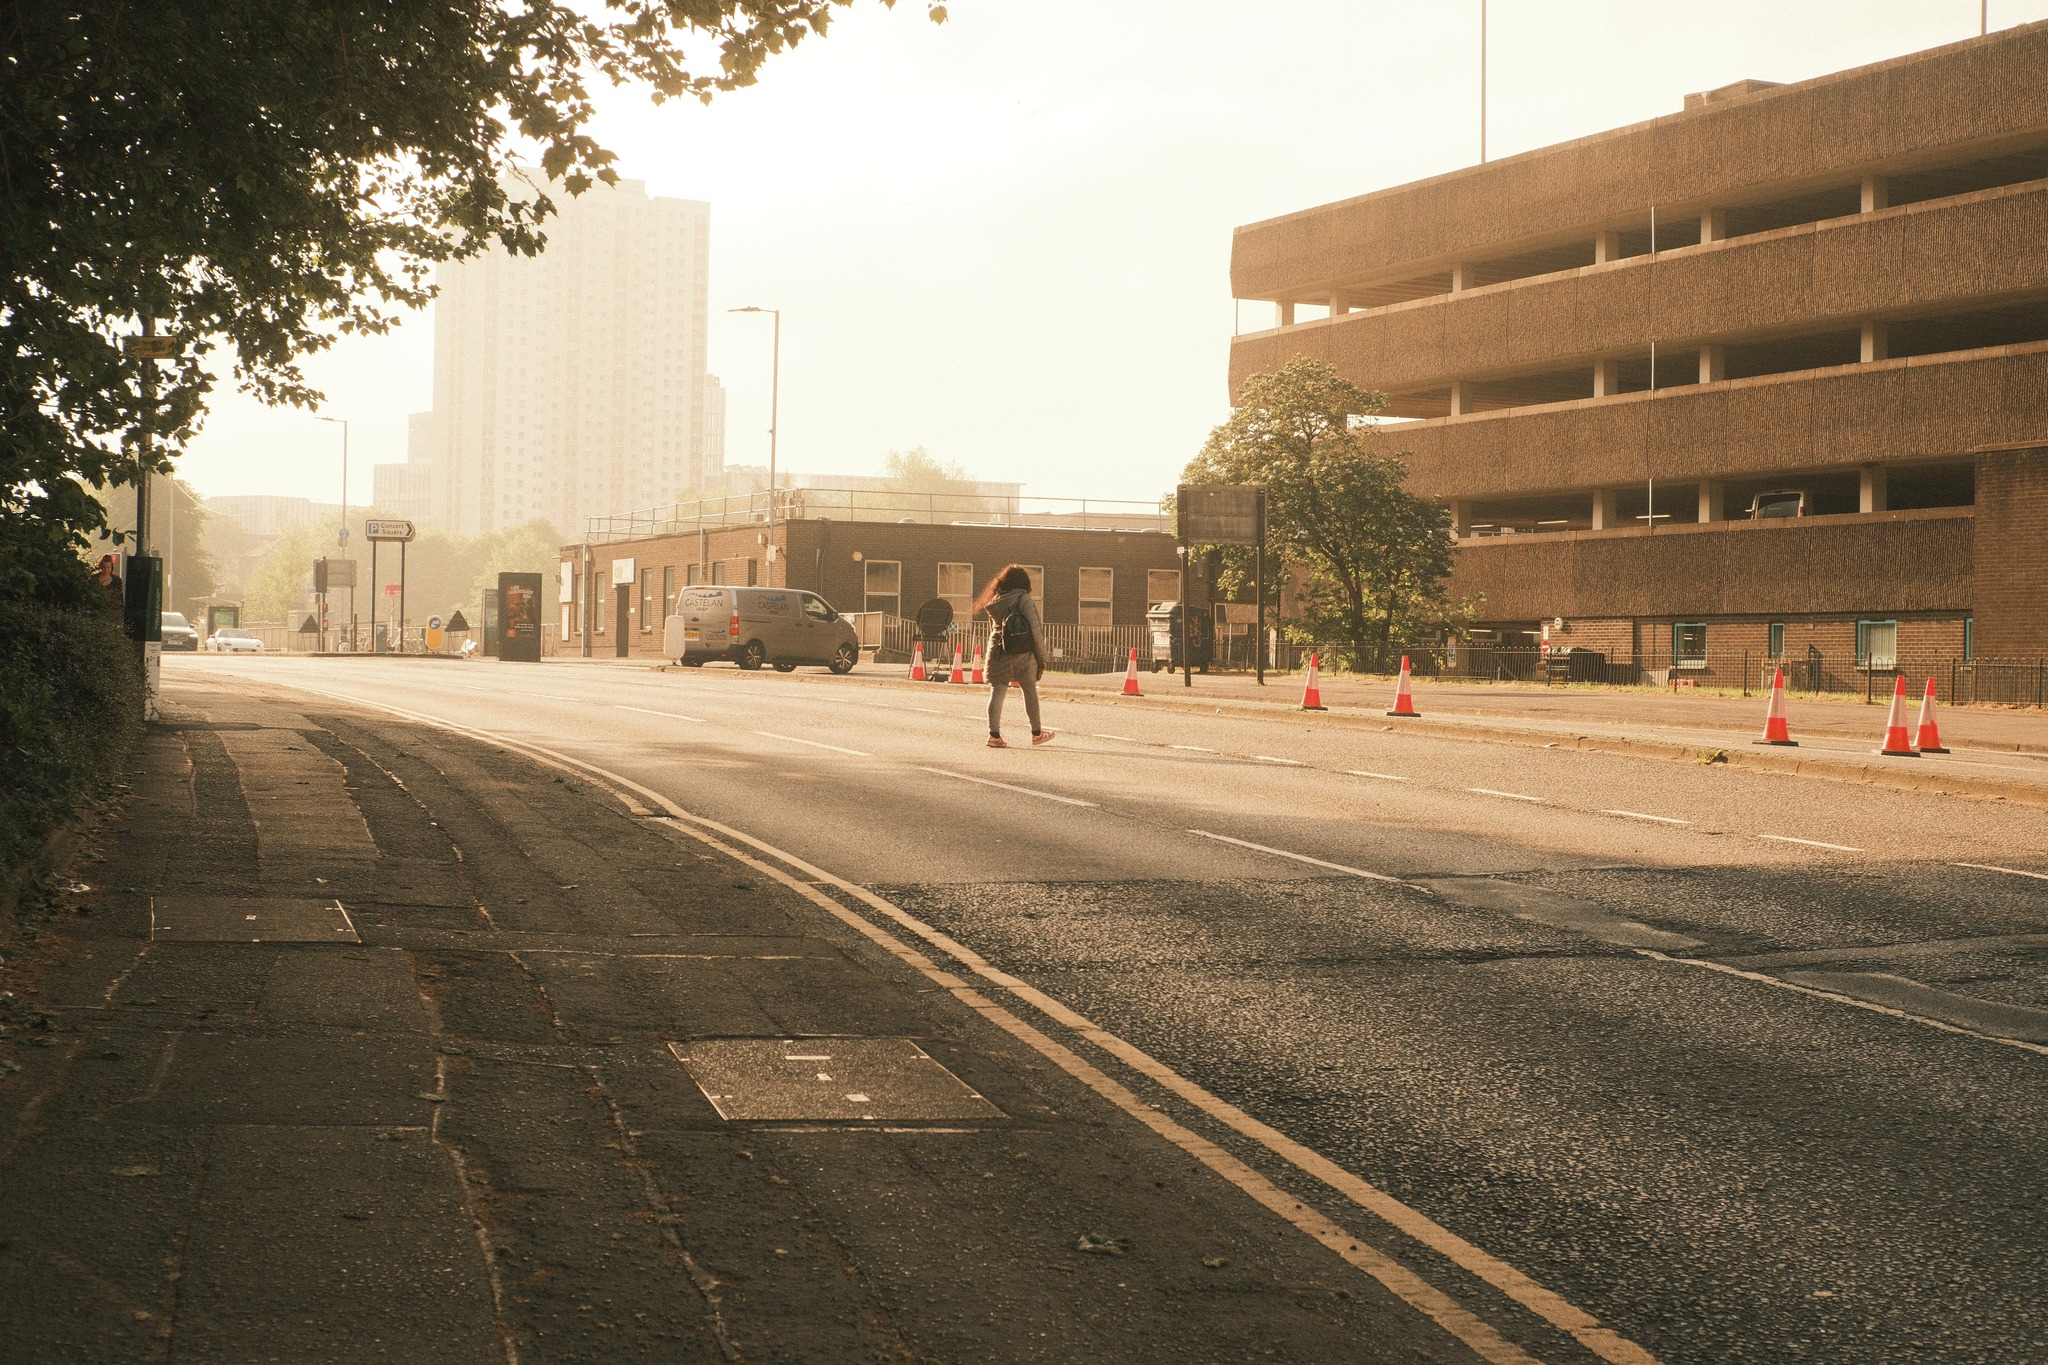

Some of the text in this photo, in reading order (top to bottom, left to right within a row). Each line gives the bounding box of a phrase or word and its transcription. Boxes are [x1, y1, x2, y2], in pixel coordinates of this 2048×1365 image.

[370, 524, 378, 534] P
[685, 599, 724, 607] CASTELAN
[758, 600, 789, 610] CASTELAN
